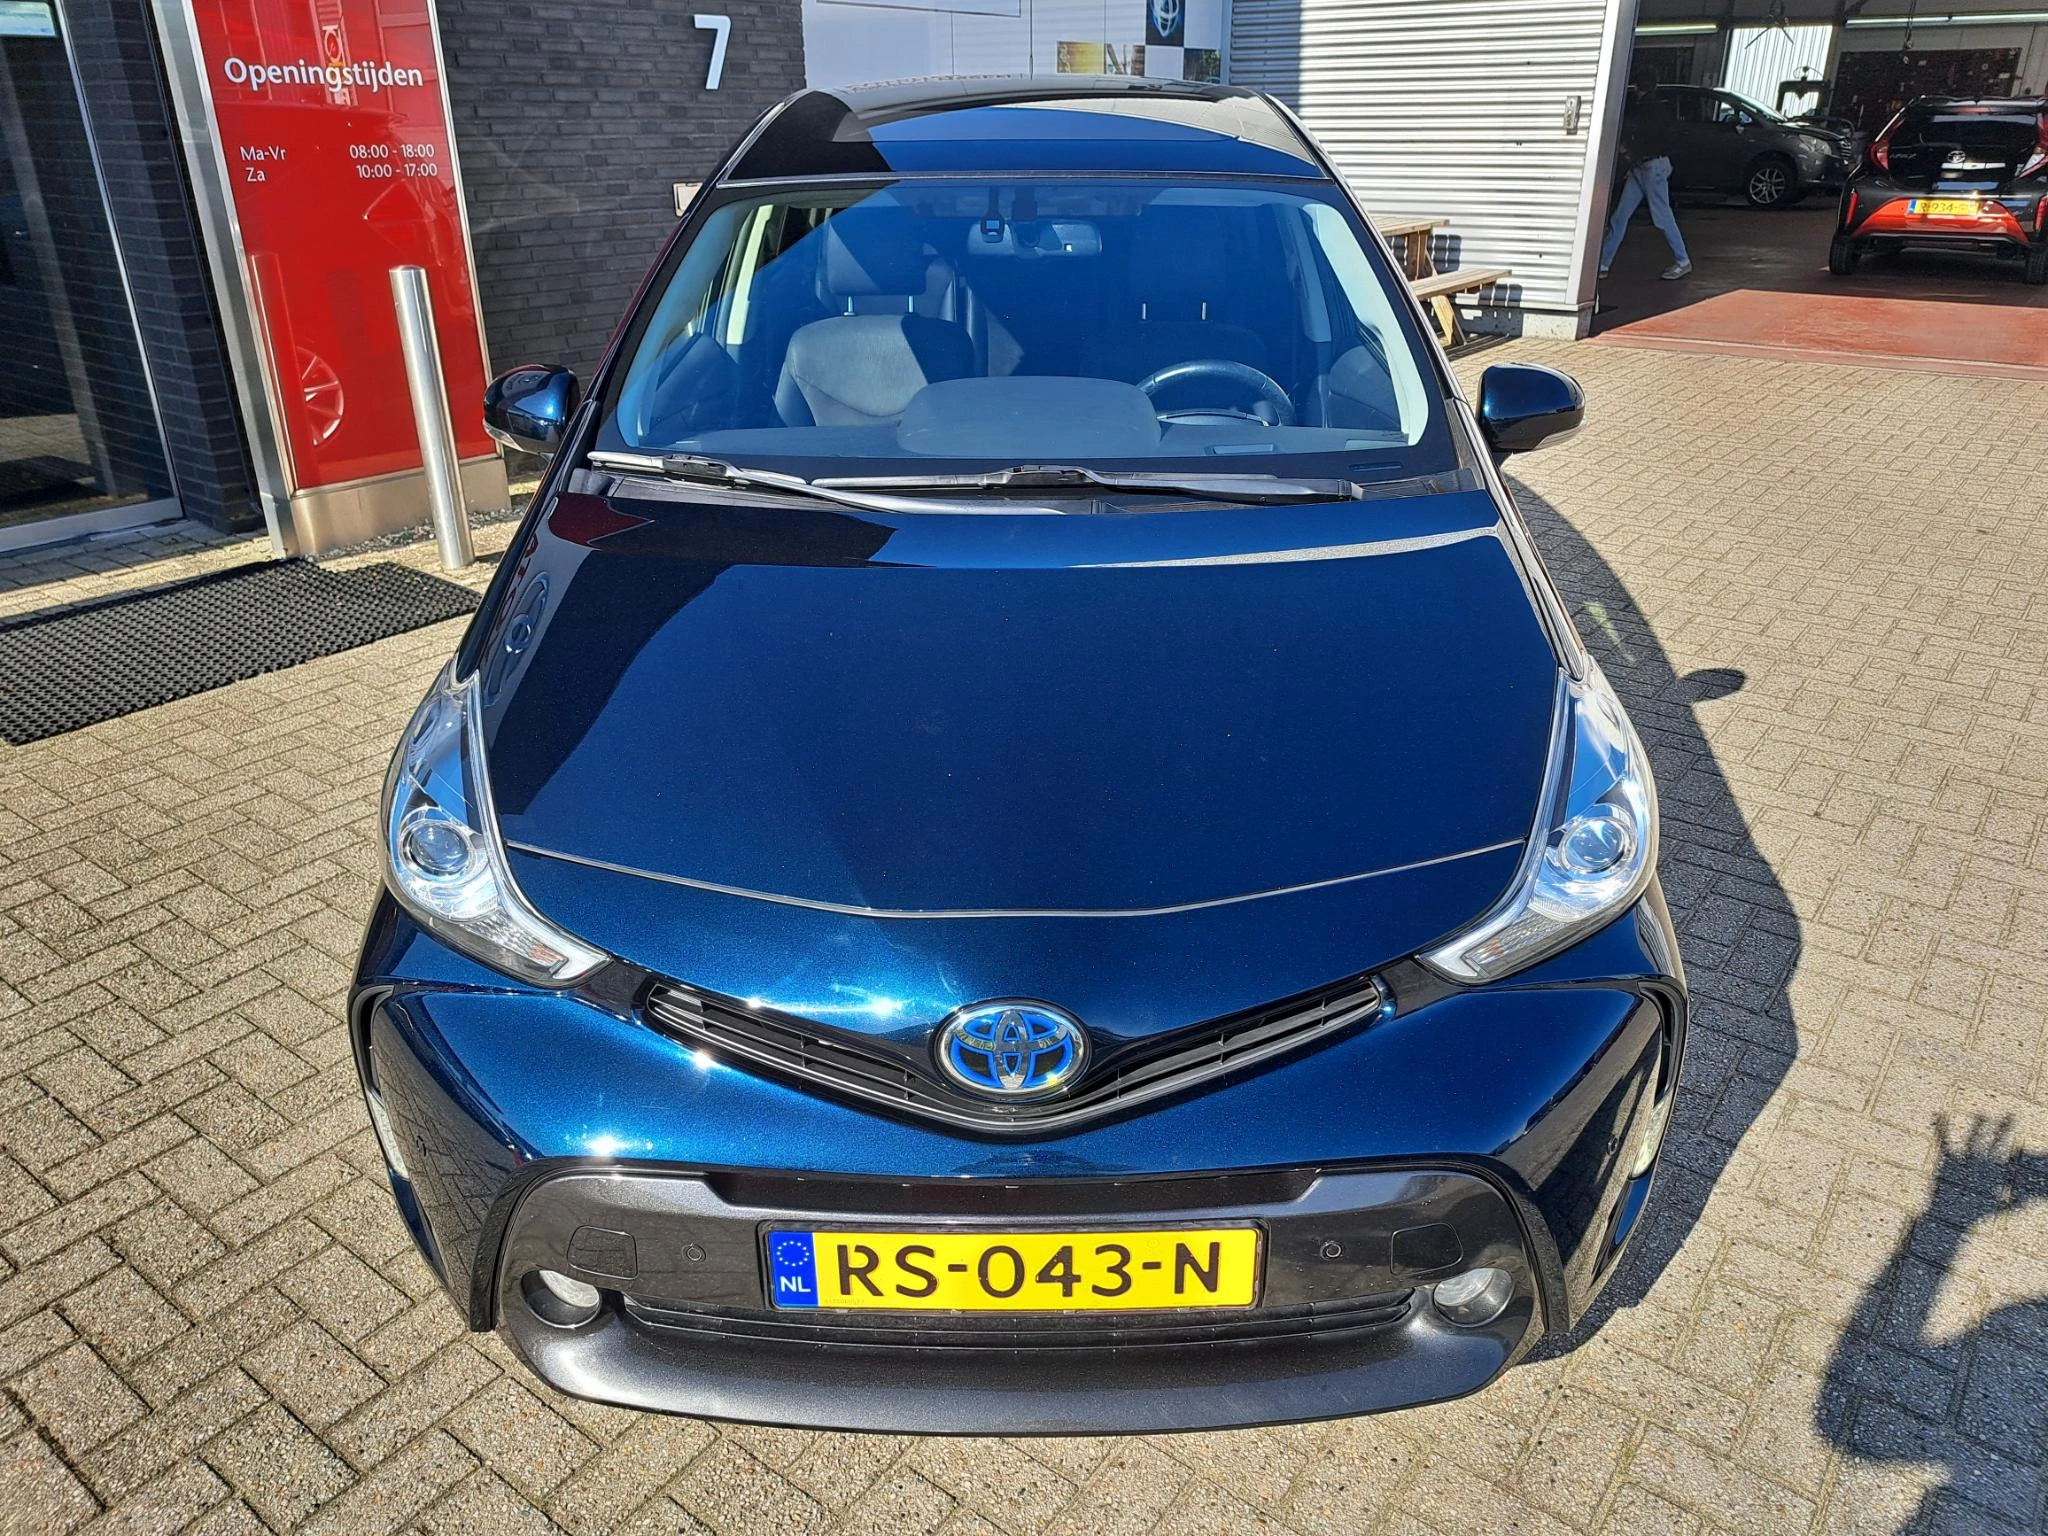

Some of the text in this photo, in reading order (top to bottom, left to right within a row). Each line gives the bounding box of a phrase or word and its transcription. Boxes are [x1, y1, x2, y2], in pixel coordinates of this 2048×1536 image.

[694, 14, 731, 89] 7
[224, 57, 423, 92] Openingstijden
[240, 145, 286, 161] Ma-Vr
[350, 144, 389, 159] 08:00
[400, 143, 435, 158] 18:00
[245, 167, 266, 182] Za
[357, 164, 392, 178] 10:00
[404, 162, 438, 177] 17:00
[836, 1241, 1220, 1298] RS-043-N
[780, 1276, 811, 1293] NL
